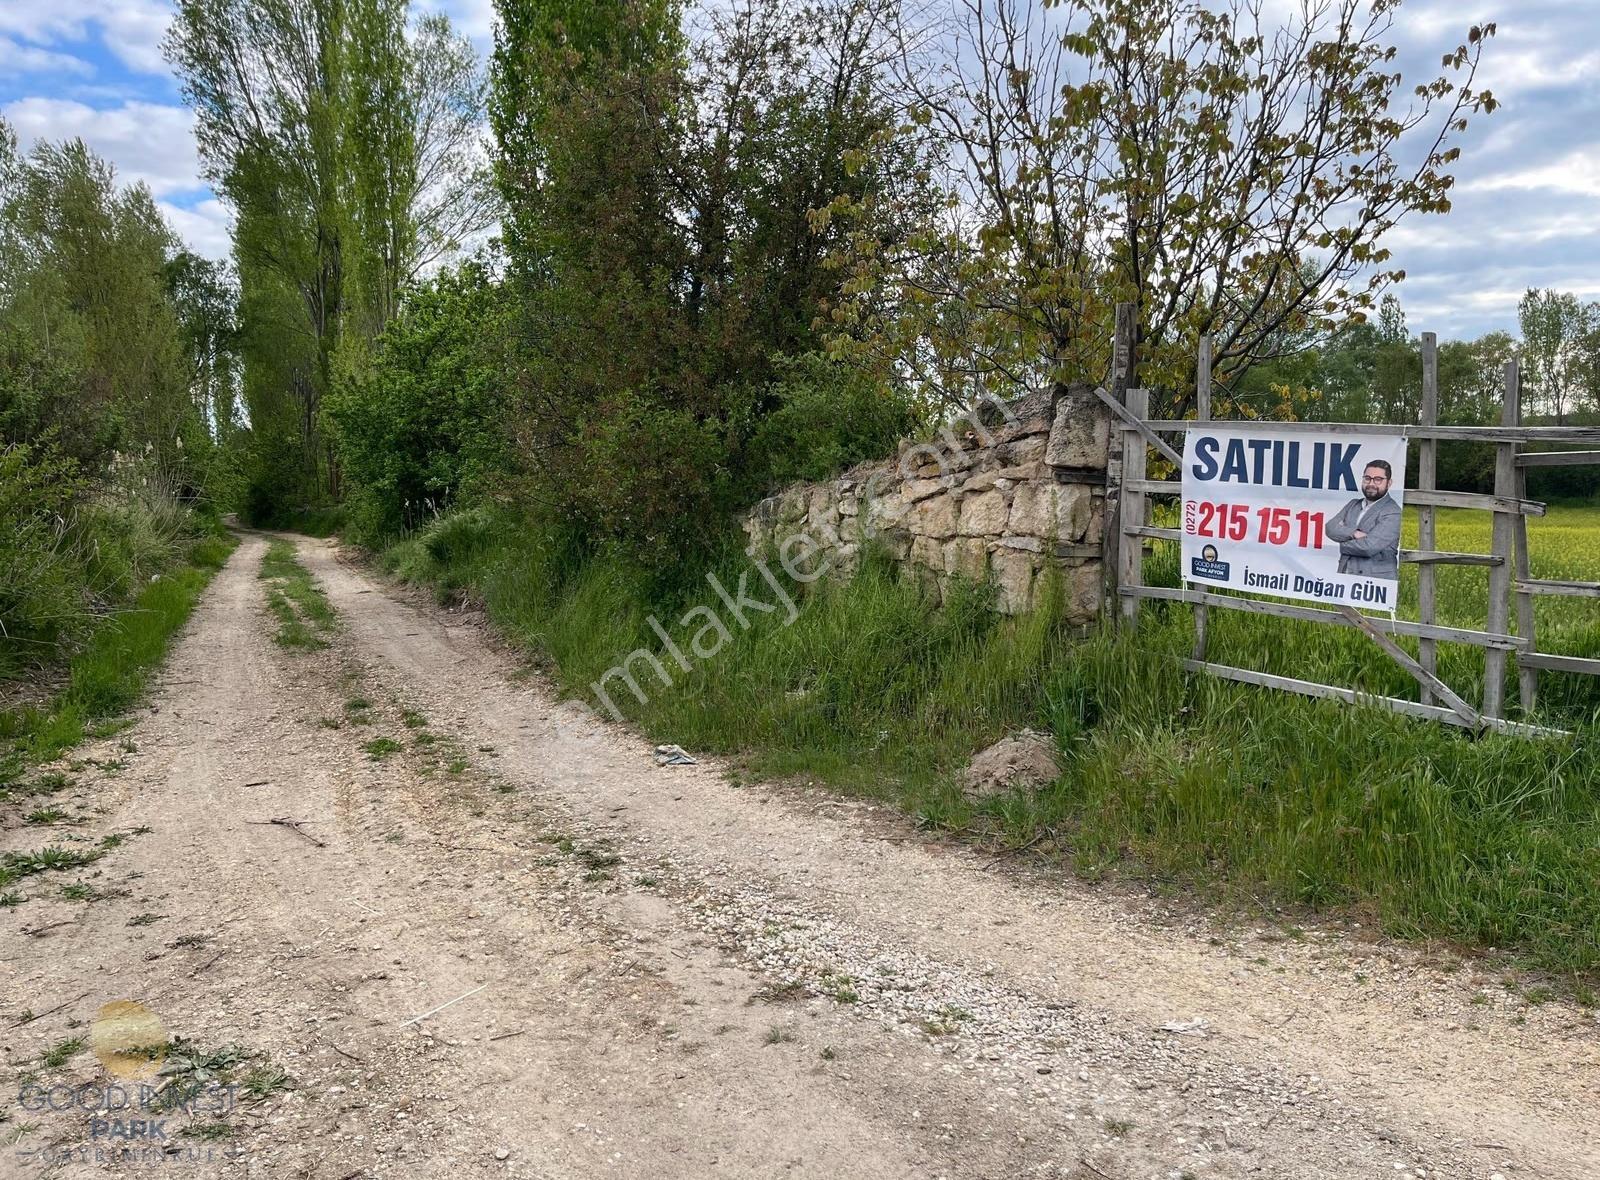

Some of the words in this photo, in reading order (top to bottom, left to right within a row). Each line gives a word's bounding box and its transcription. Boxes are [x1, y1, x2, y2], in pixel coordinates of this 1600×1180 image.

[1193, 437, 1362, 492] SATILIK
[1185, 500, 1197, 535] (0272)
[1198, 501, 1249, 541] 215
[1257, 507, 1291, 545] 15
[1295, 510, 1324, 549] 11
[1244, 566, 1289, 591] İsmail
[1294, 575, 1345, 598] Doğan
[1350, 579, 1387, 604] GÜN
